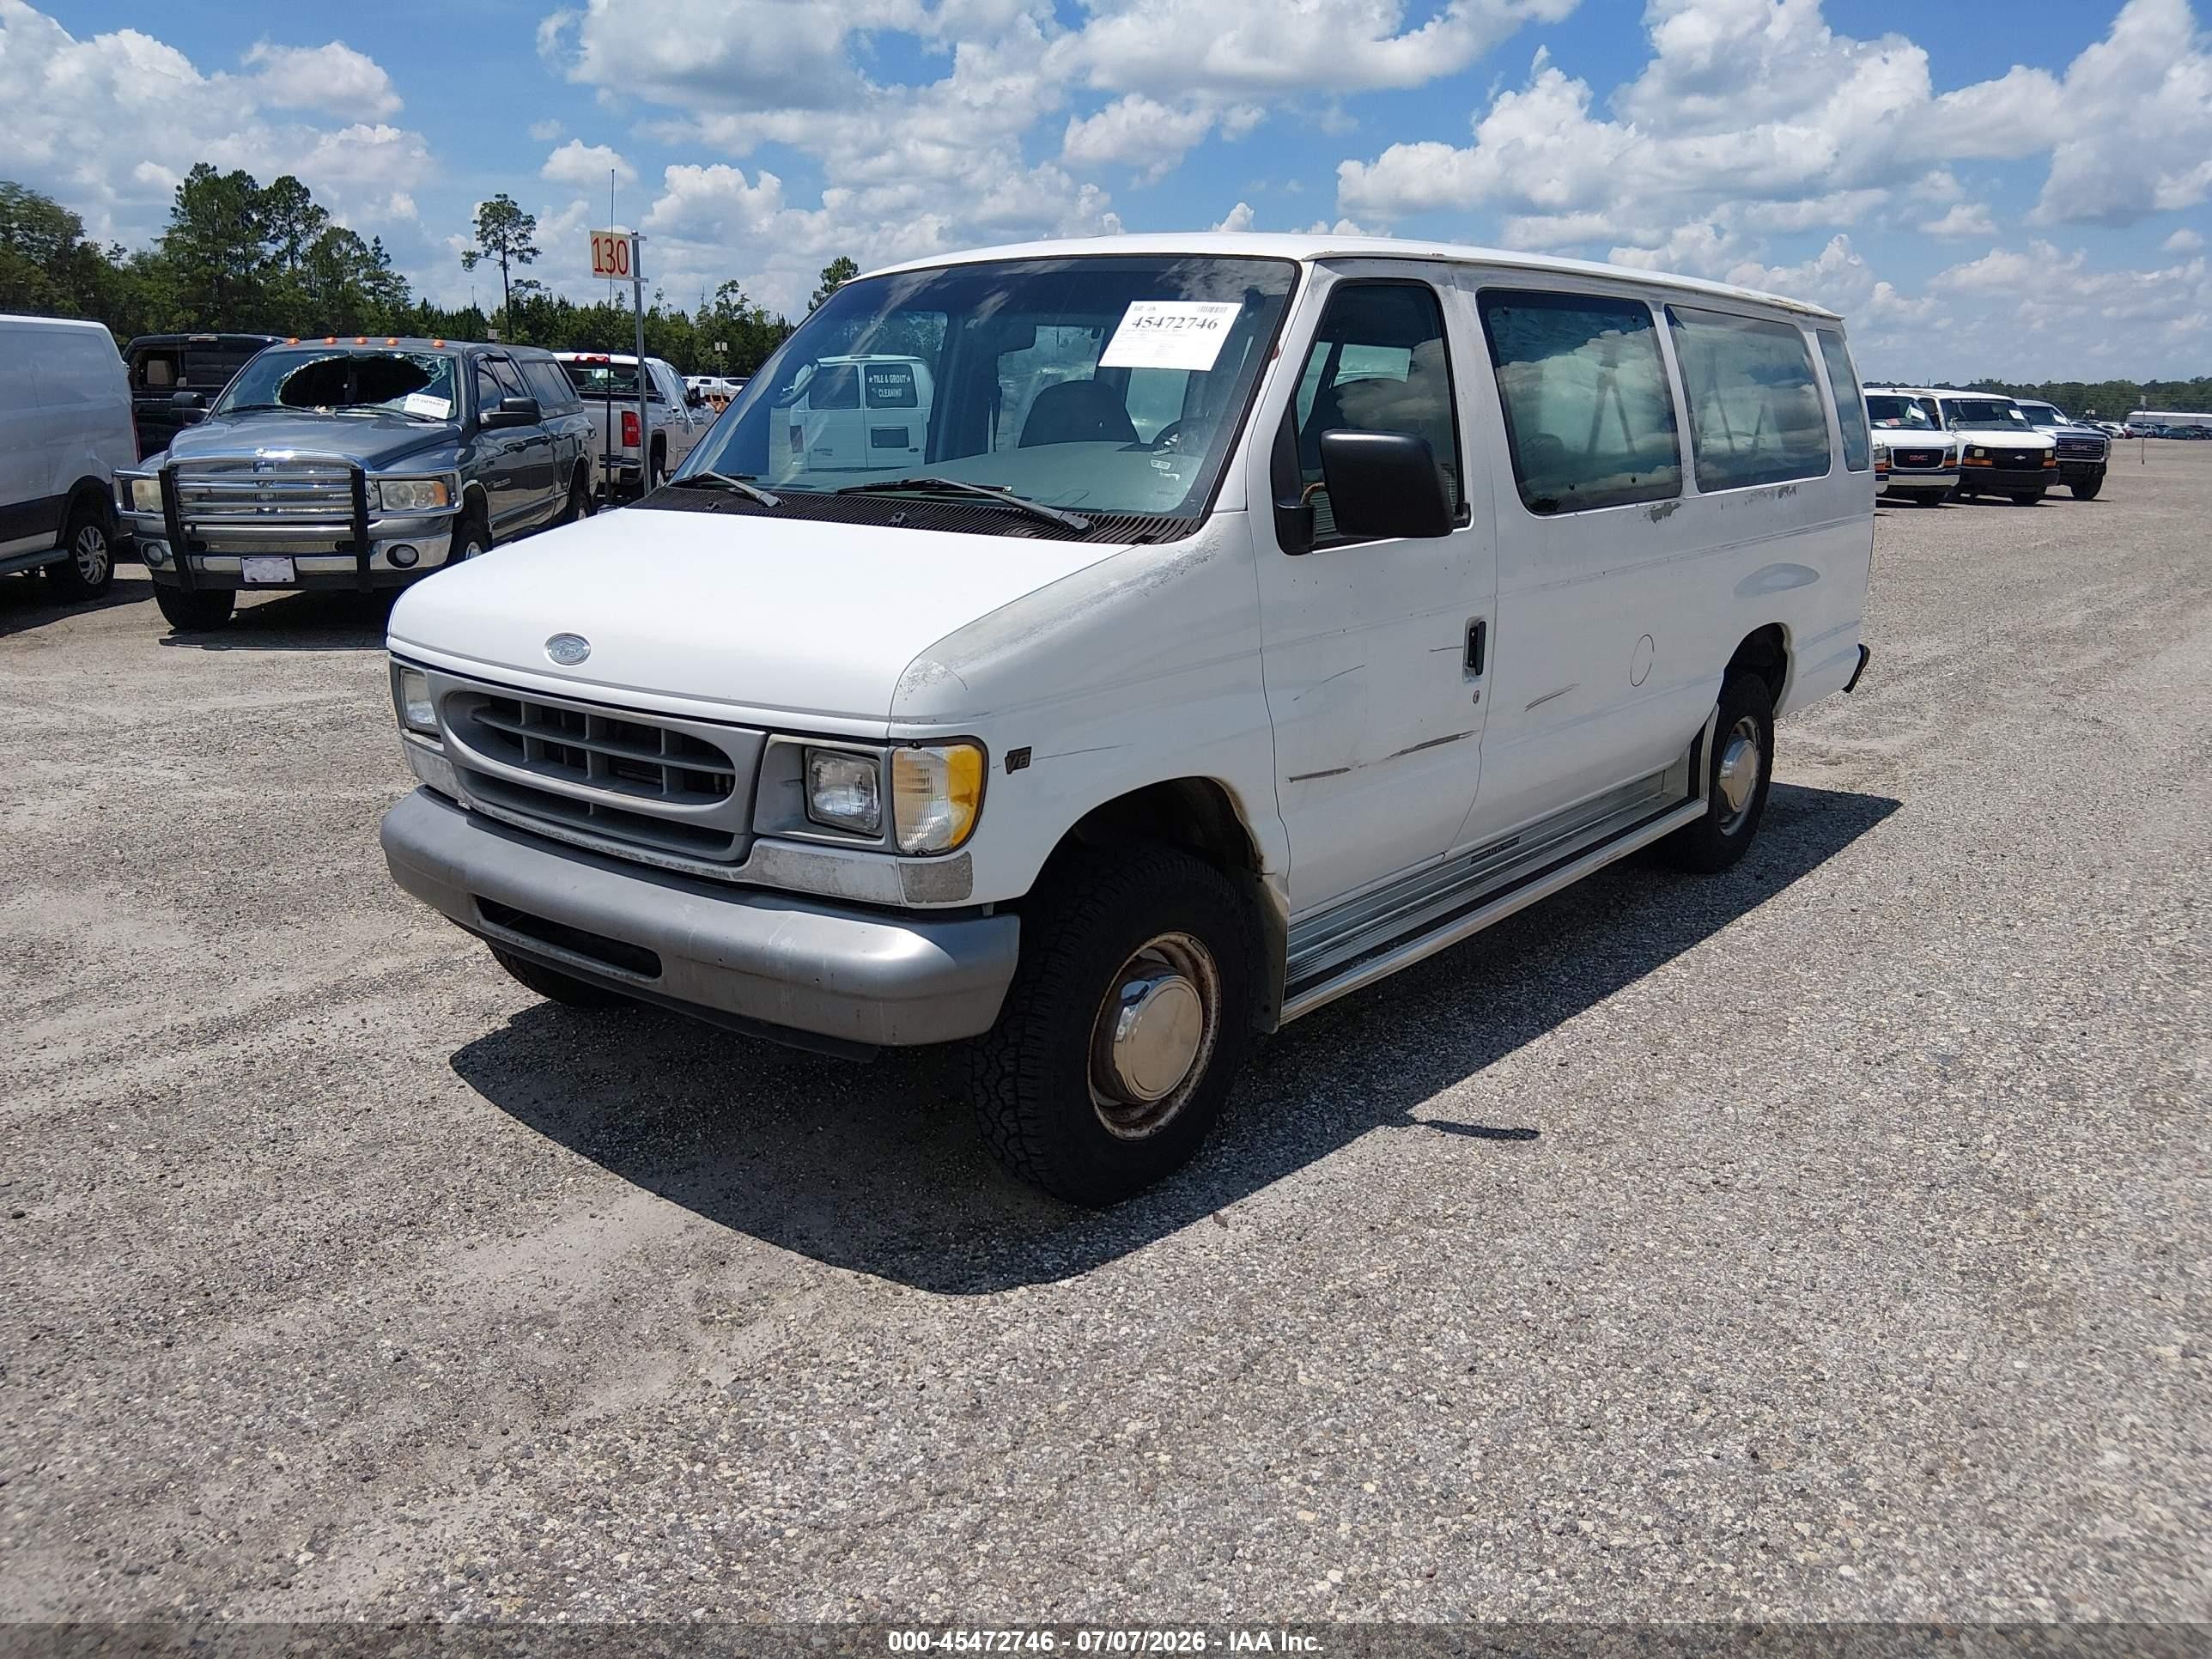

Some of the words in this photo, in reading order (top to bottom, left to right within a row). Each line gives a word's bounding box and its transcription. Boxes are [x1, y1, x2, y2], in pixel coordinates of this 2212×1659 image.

[592, 237, 629, 275] 130
[1132, 316, 1220, 331] 45472746
[873, 374, 884, 383] TILE
[885, 374, 889, 383] &
[890, 374, 906, 383] GROUT
[878, 389, 902, 398] CLEANING
[1005, 753, 1030, 773] V8
